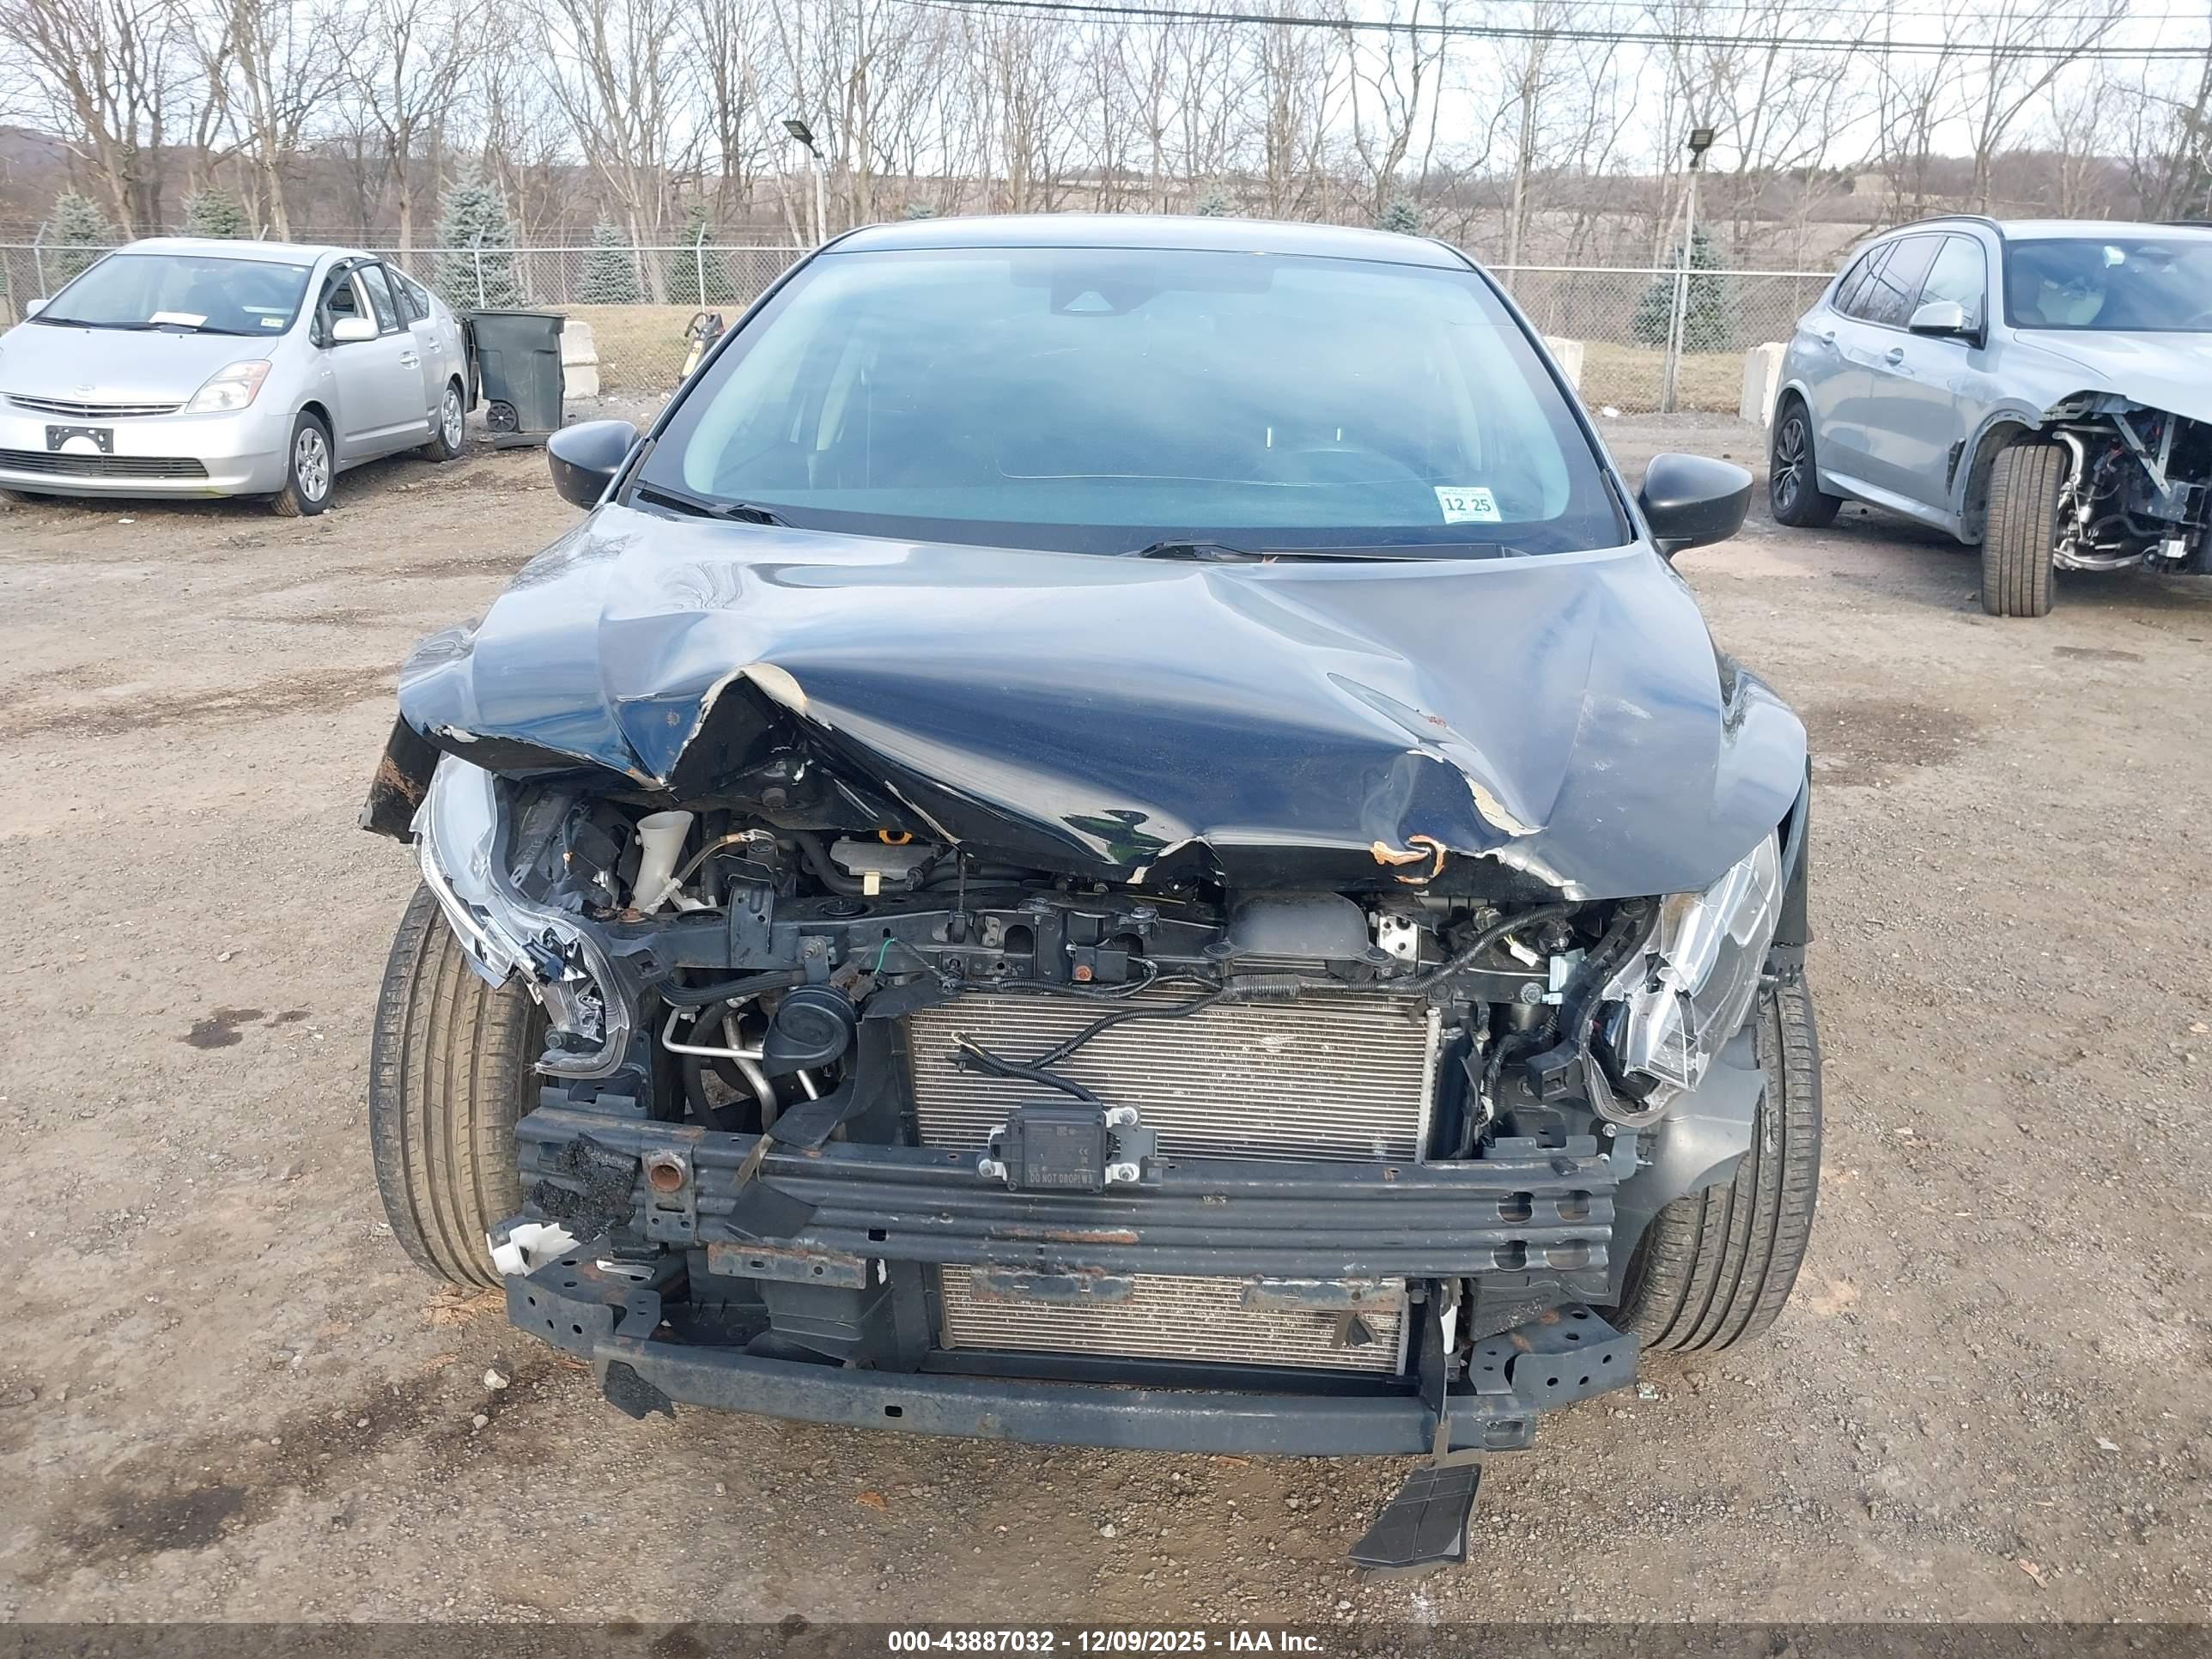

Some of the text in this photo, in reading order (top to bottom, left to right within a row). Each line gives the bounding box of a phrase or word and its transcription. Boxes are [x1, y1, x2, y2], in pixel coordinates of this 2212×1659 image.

[1444, 498, 1492, 512] 12 25
[1030, 1173, 1041, 1183] DO
[1042, 1173, 1057, 1183] NOT
